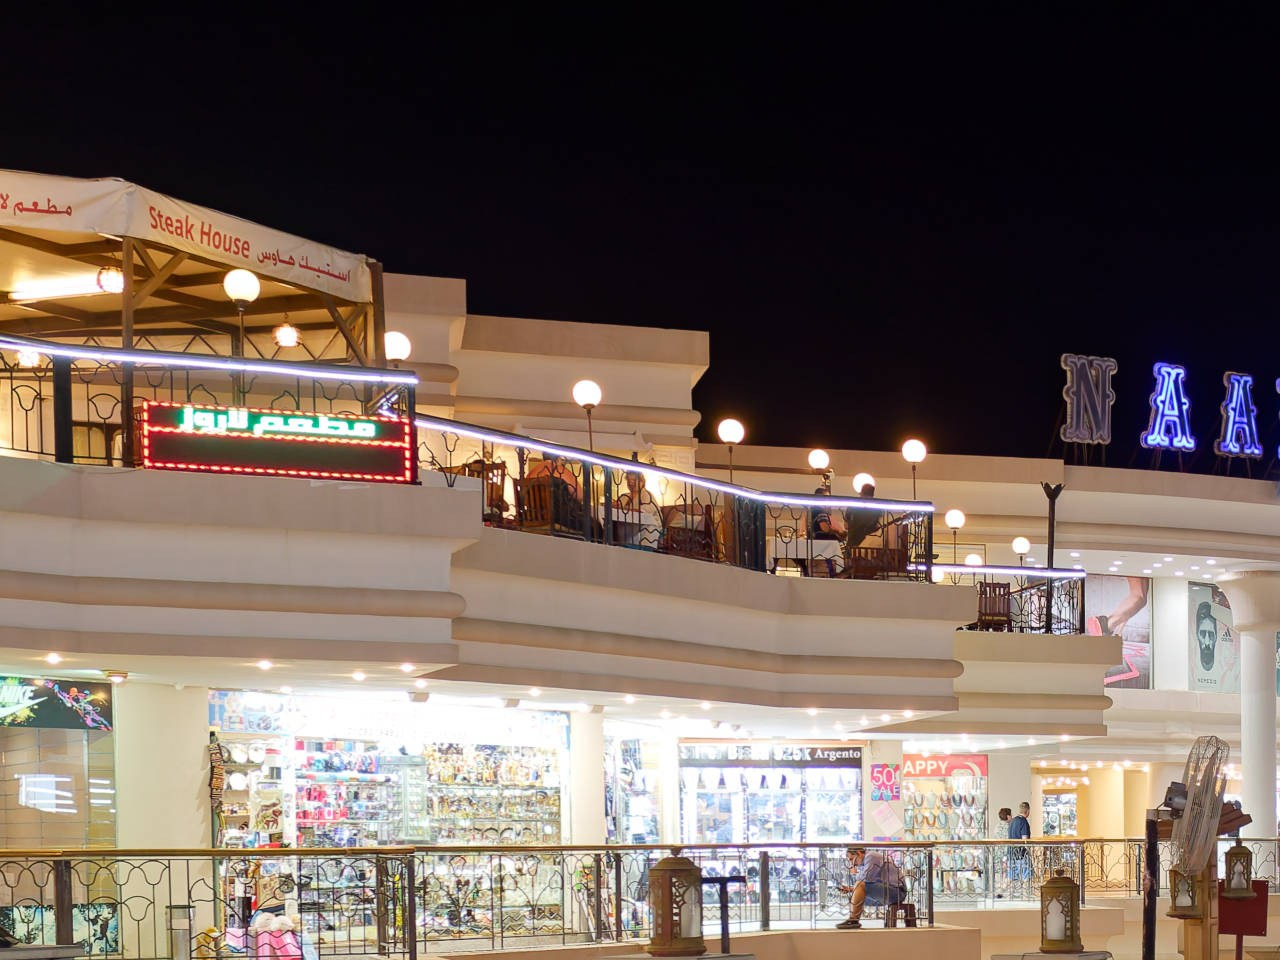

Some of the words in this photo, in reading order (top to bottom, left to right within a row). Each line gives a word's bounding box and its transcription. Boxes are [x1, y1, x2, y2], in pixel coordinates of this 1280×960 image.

[13, 197, 73, 216] مطعم
[149, 206, 195, 241] Steak
[200, 221, 250, 259] House
[253, 414, 376, 437] مطعم
[815, 748, 862, 761] Argento
[871, 786, 901, 796] SALE
